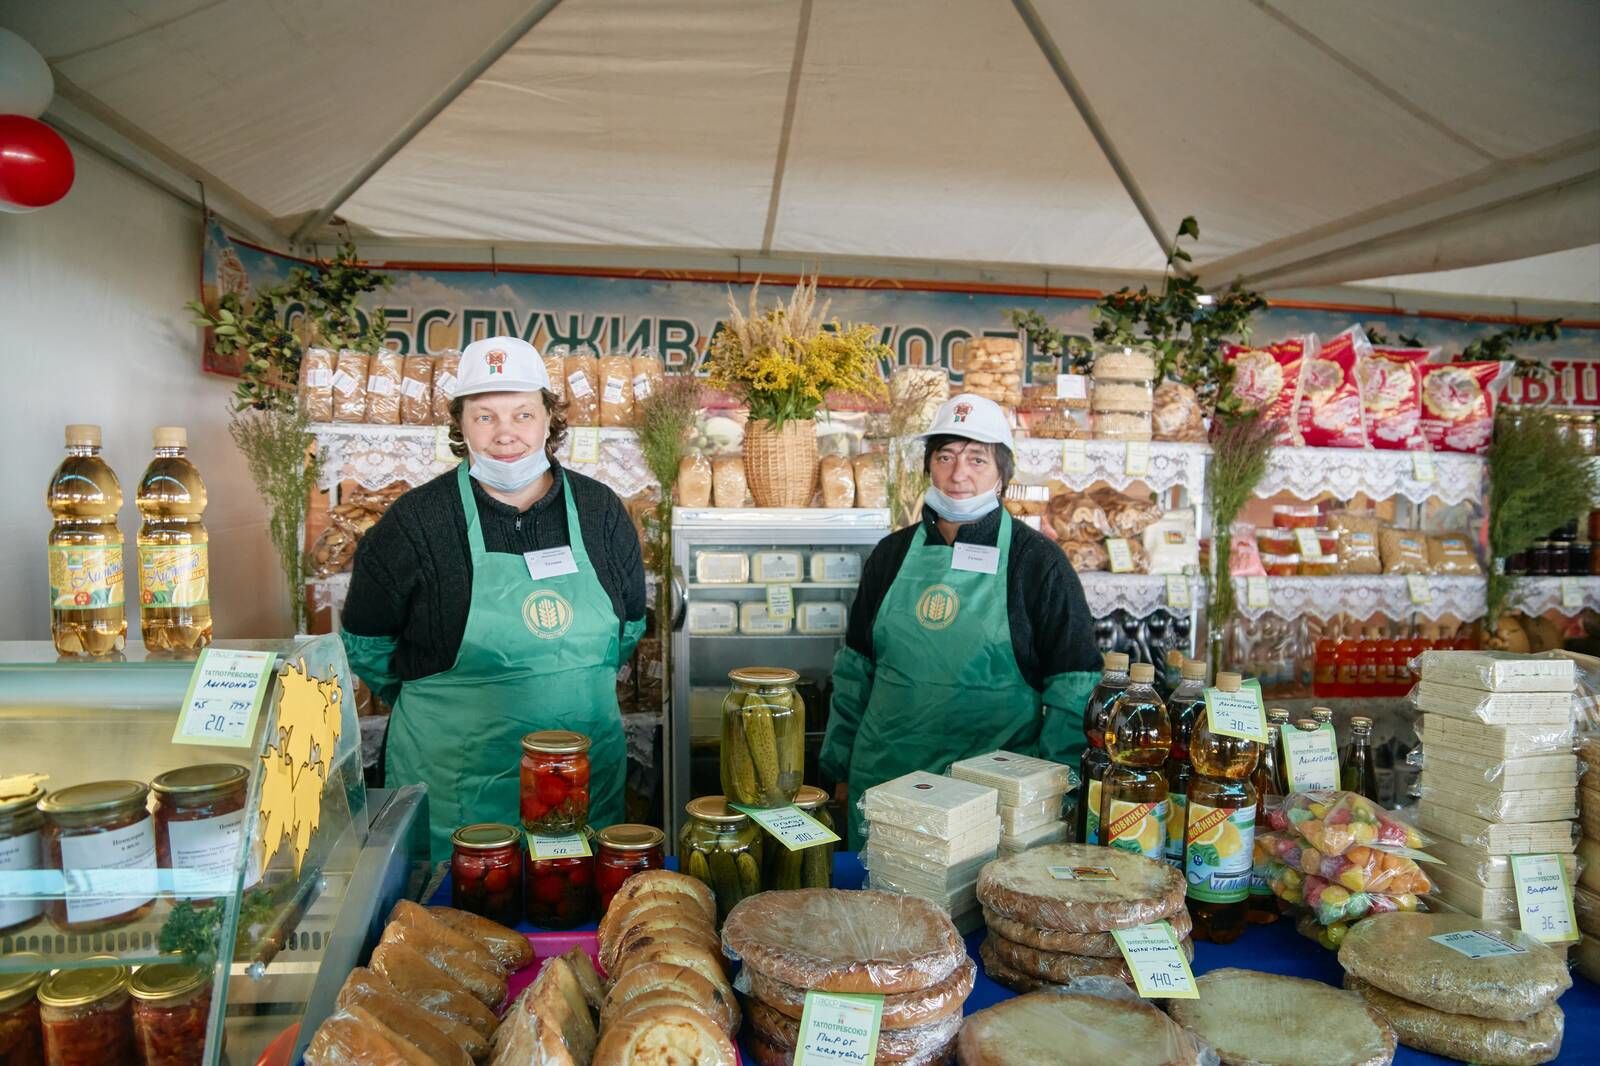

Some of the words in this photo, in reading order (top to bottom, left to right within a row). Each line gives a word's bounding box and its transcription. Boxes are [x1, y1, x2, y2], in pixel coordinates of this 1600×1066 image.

[204, 669, 259, 679] ТАТПОТРЕБСОЮЗ
[1110, 804, 1150, 835] НОВИНКА!
[1188, 808, 1227, 838] НОВИНКА!
[813, 1020, 868, 1037] ТАТПОТРЕБСОЮЗ
[816, 1032, 857, 1046] Пирог
